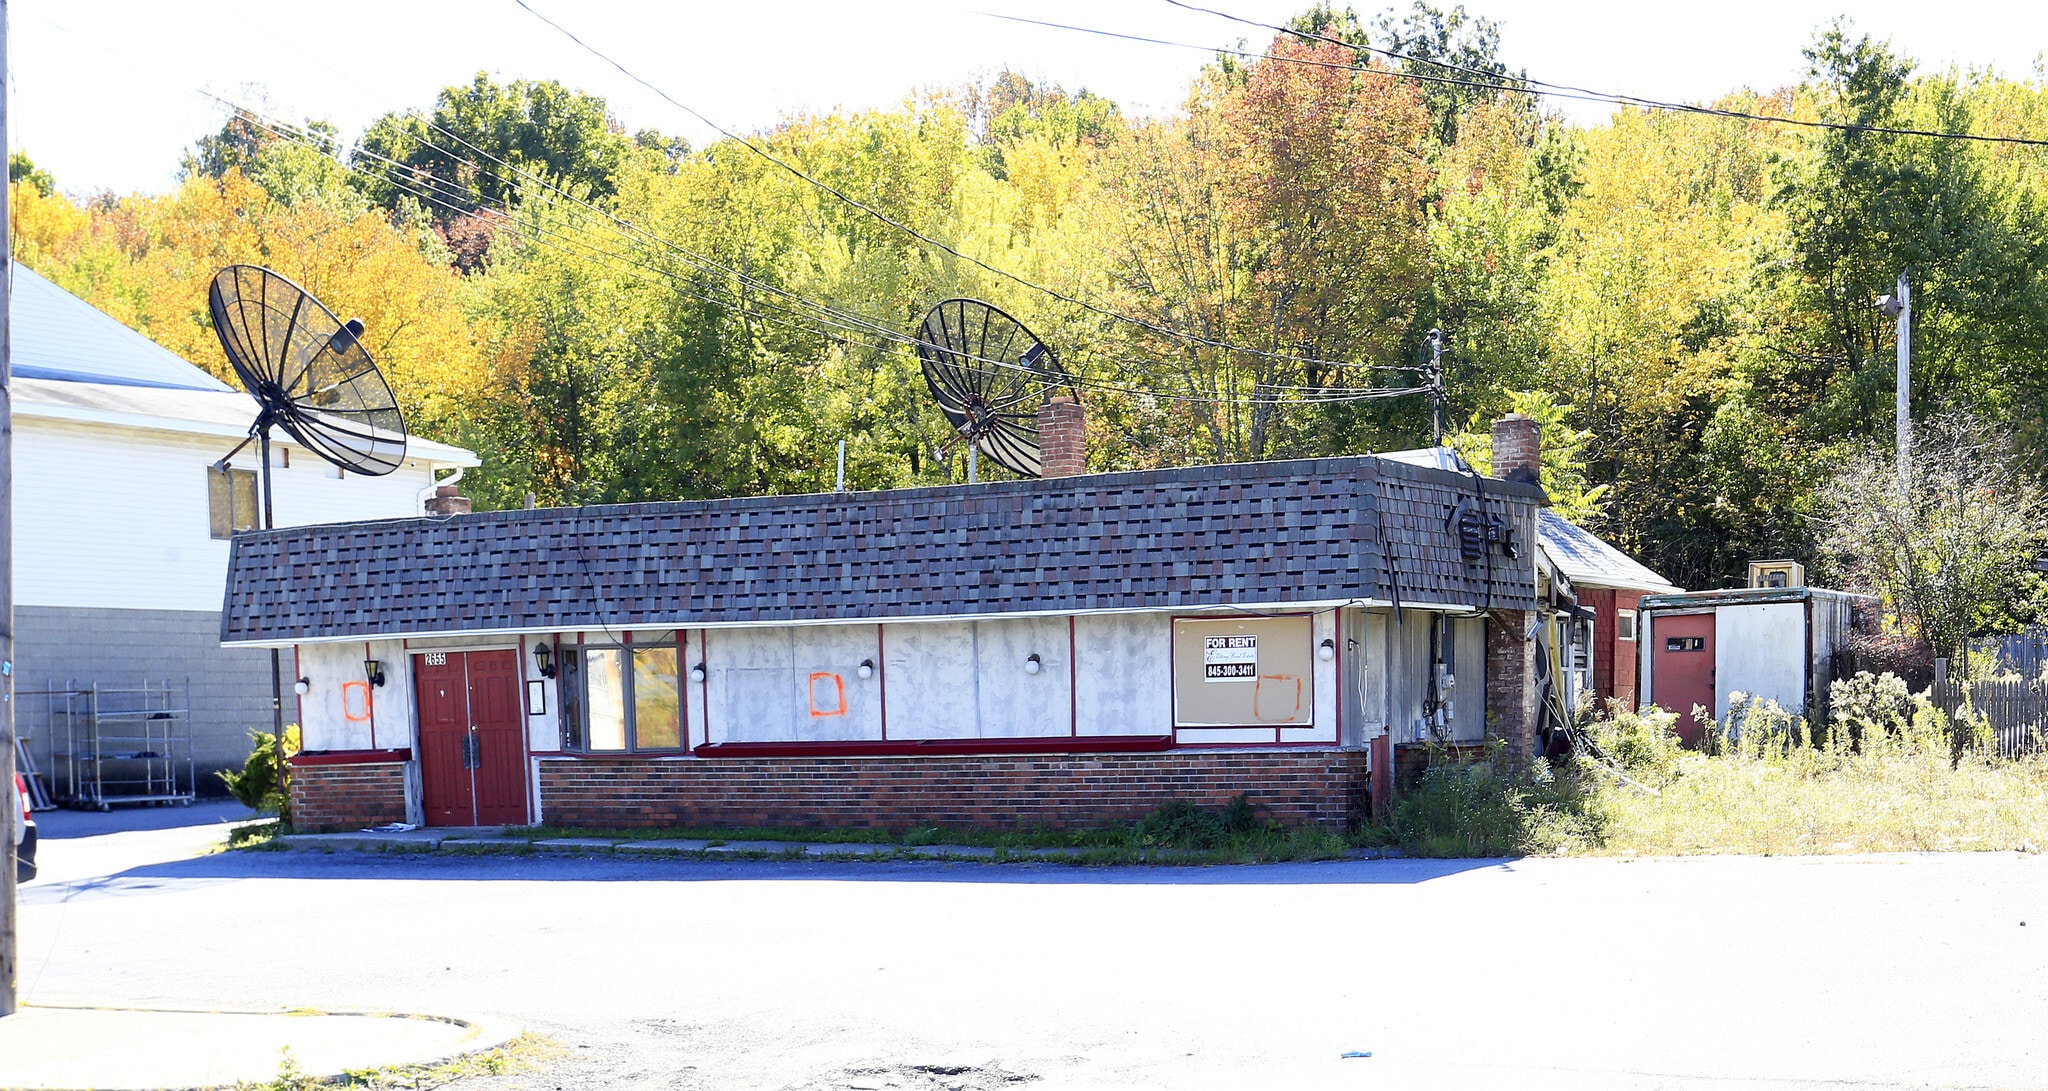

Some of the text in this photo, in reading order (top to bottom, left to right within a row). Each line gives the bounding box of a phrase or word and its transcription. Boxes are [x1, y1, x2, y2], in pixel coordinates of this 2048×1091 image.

[1206, 637, 1255, 648] FOR RENT
[426, 653, 445, 665] 2655
[1208, 664, 1254, 677] 845-300-3411
